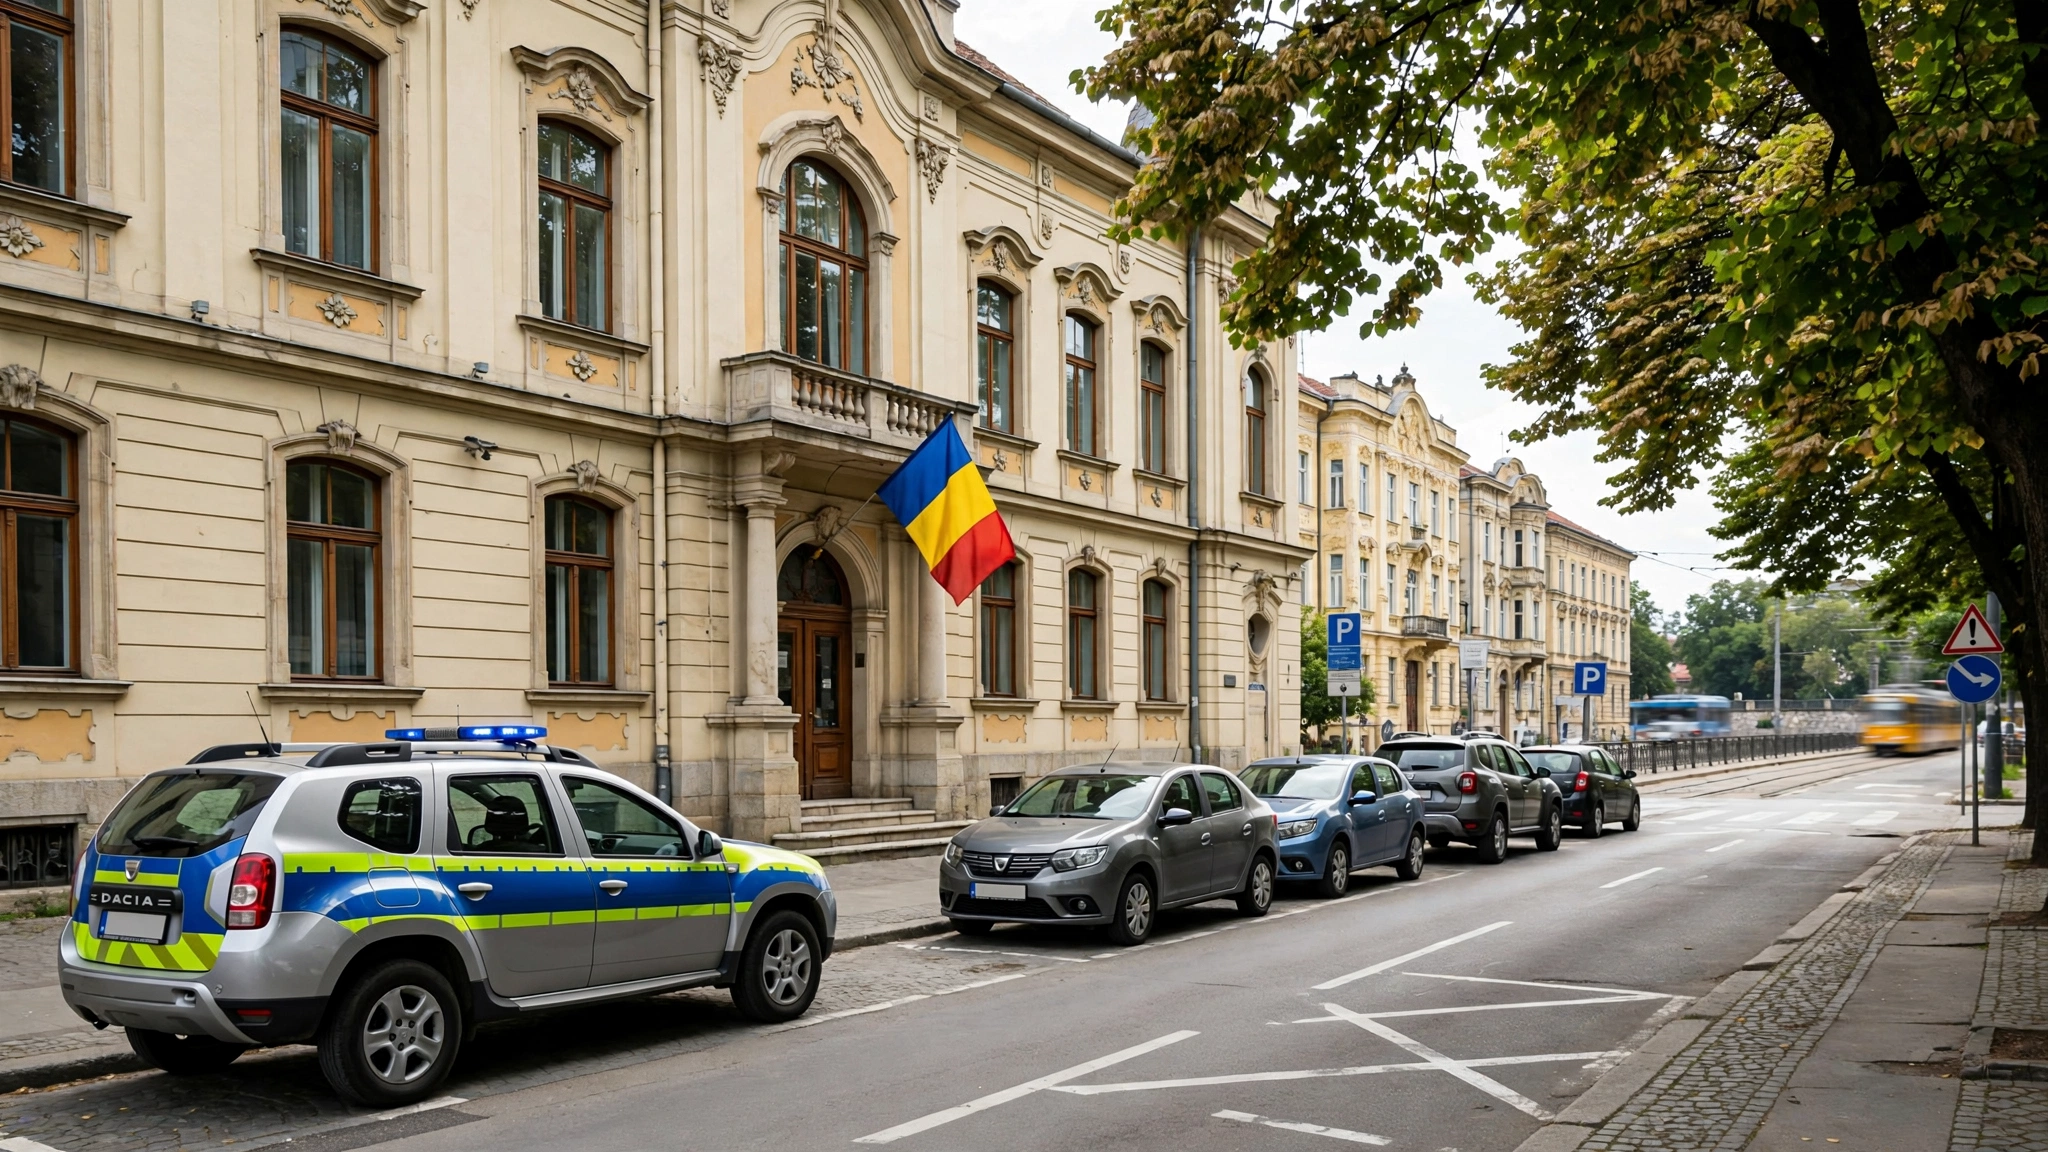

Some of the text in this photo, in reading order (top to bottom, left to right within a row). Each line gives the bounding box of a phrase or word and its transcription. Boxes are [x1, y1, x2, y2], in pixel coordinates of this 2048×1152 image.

[1337, 618, 1353, 643] P
[1582, 667, 1600, 691] P
[101, 893, 153, 906] DACIA
